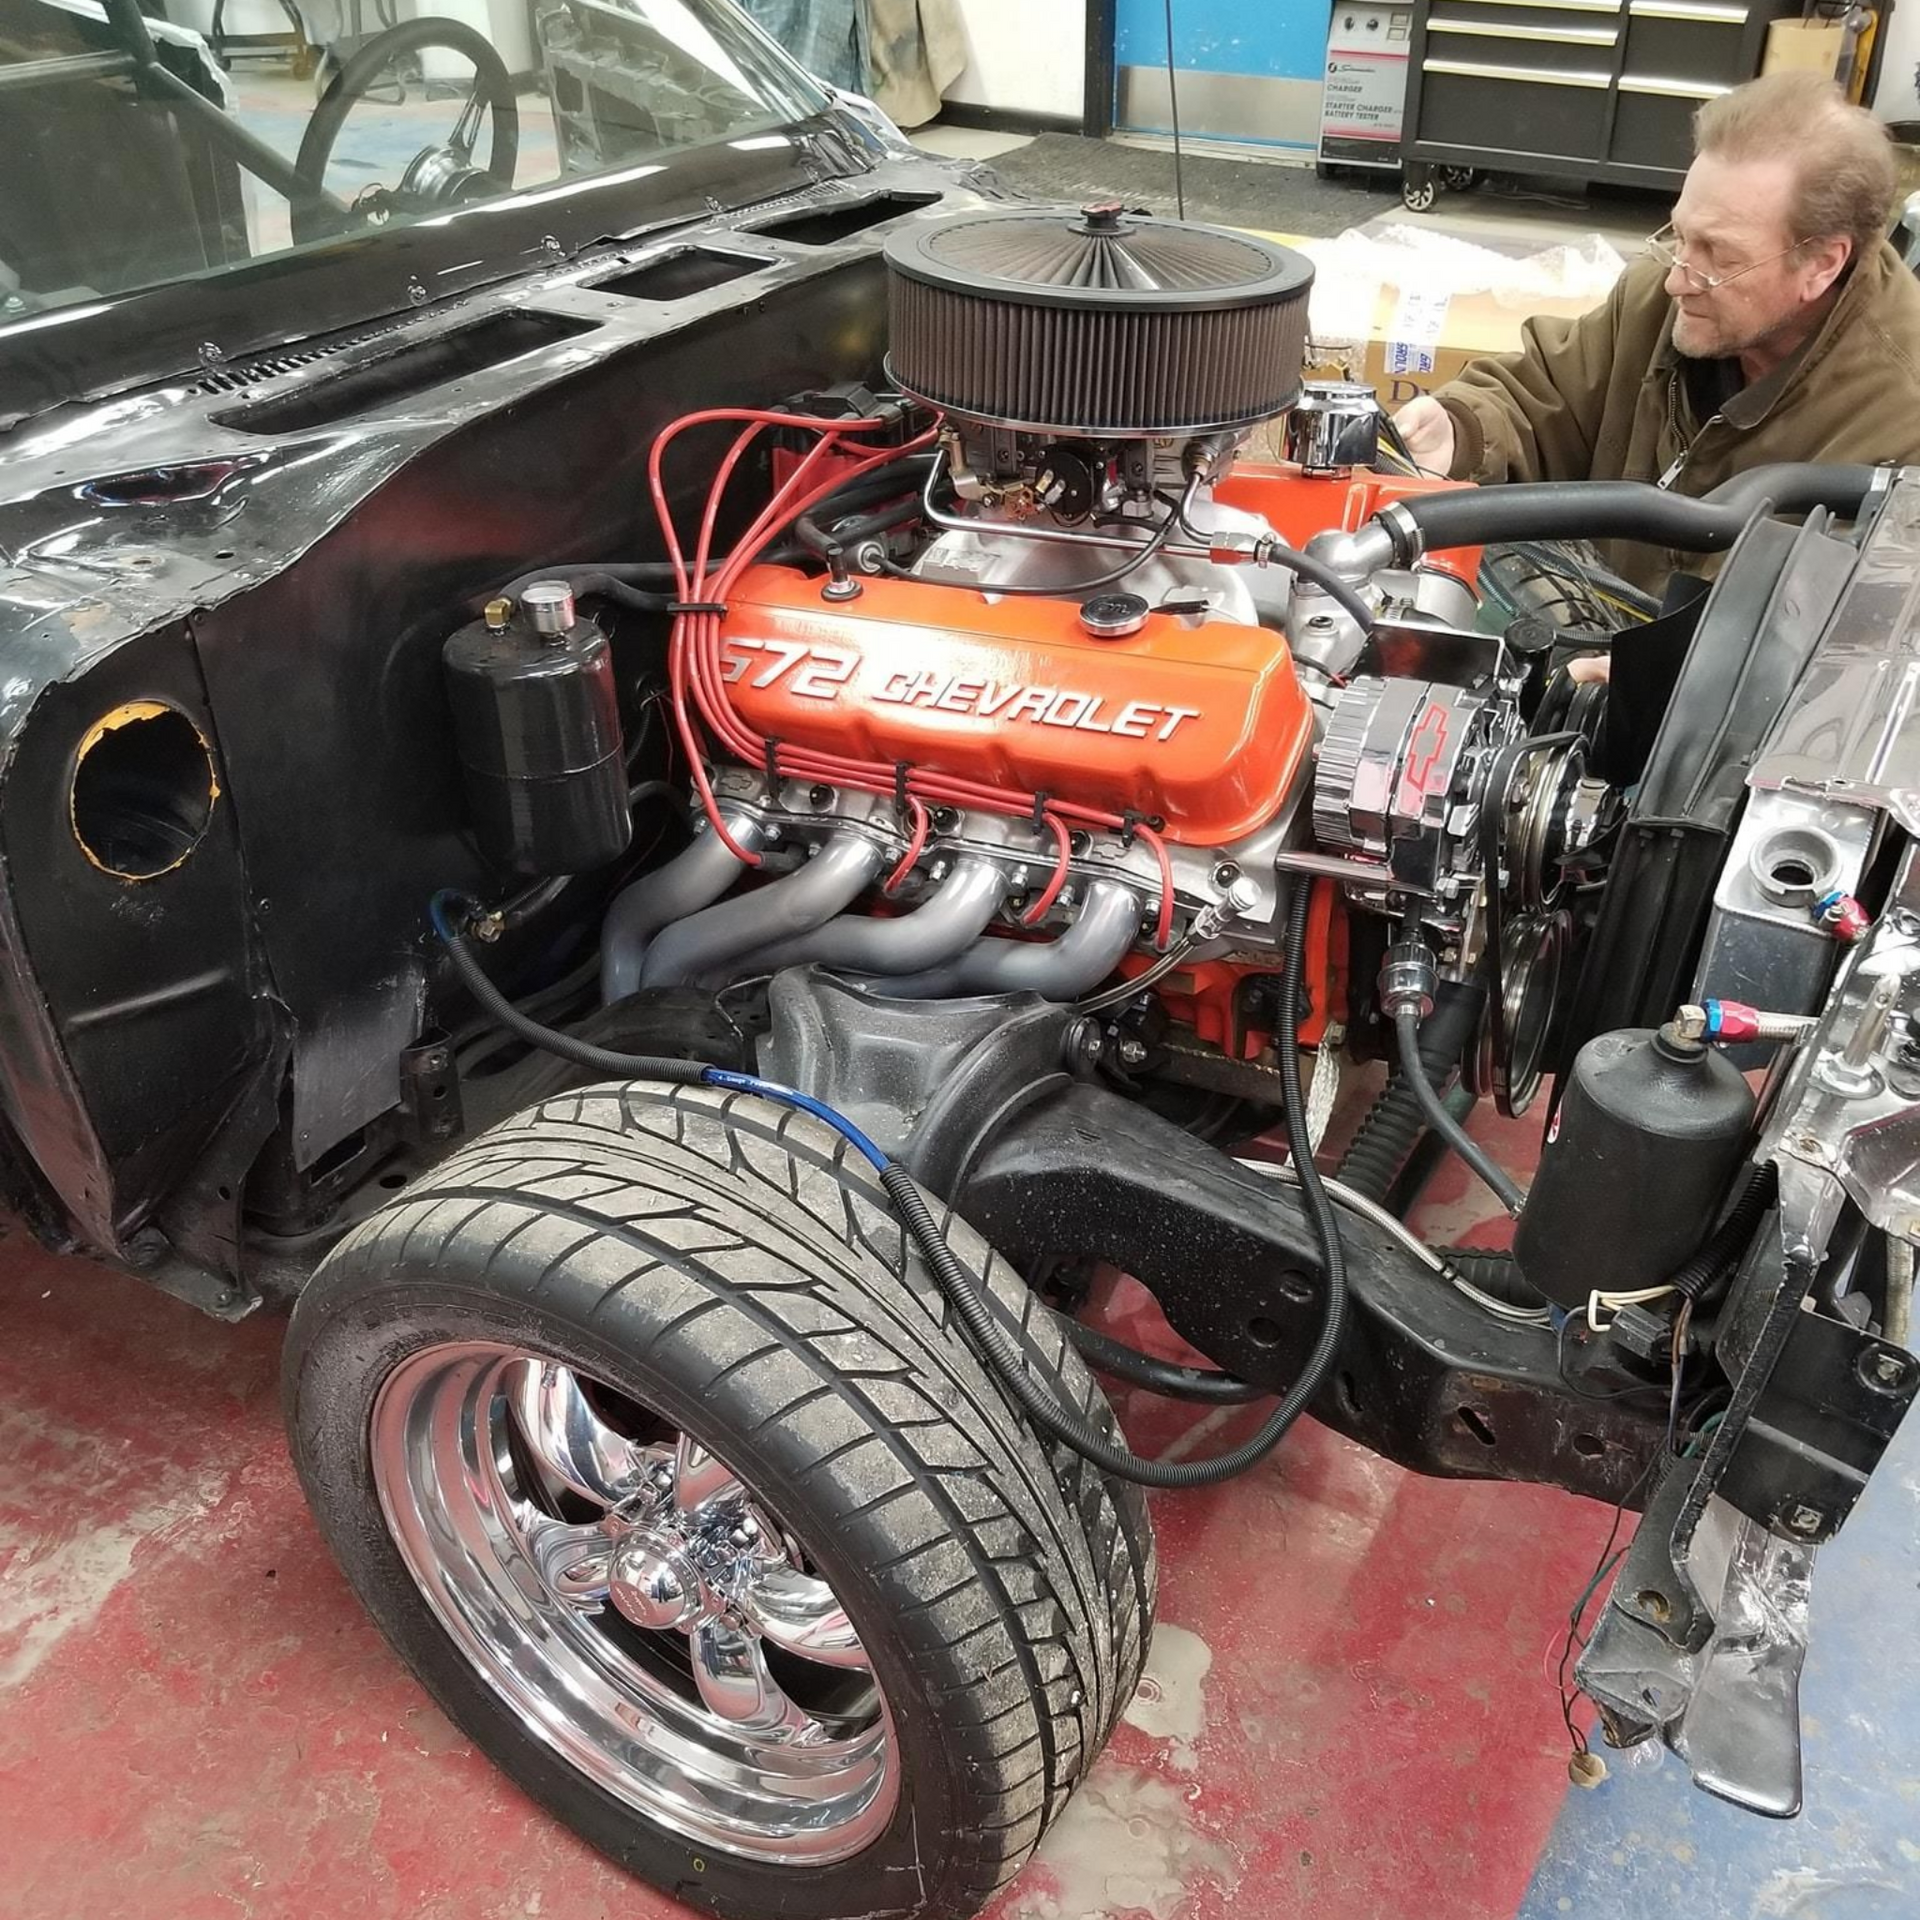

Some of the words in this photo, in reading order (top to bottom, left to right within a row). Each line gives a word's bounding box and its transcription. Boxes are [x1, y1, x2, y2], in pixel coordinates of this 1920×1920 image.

[1327, 84, 1363, 93] CHARGER
[1325, 102, 1355, 111] STARTER
[1357, 104, 1393, 113] CHARGER
[1325, 110, 1354, 119] BATTERY
[1356, 112, 1379, 120] TESTER
[719, 638, 860, 700] 572
[871, 669, 1201, 742] CHEVROLET
